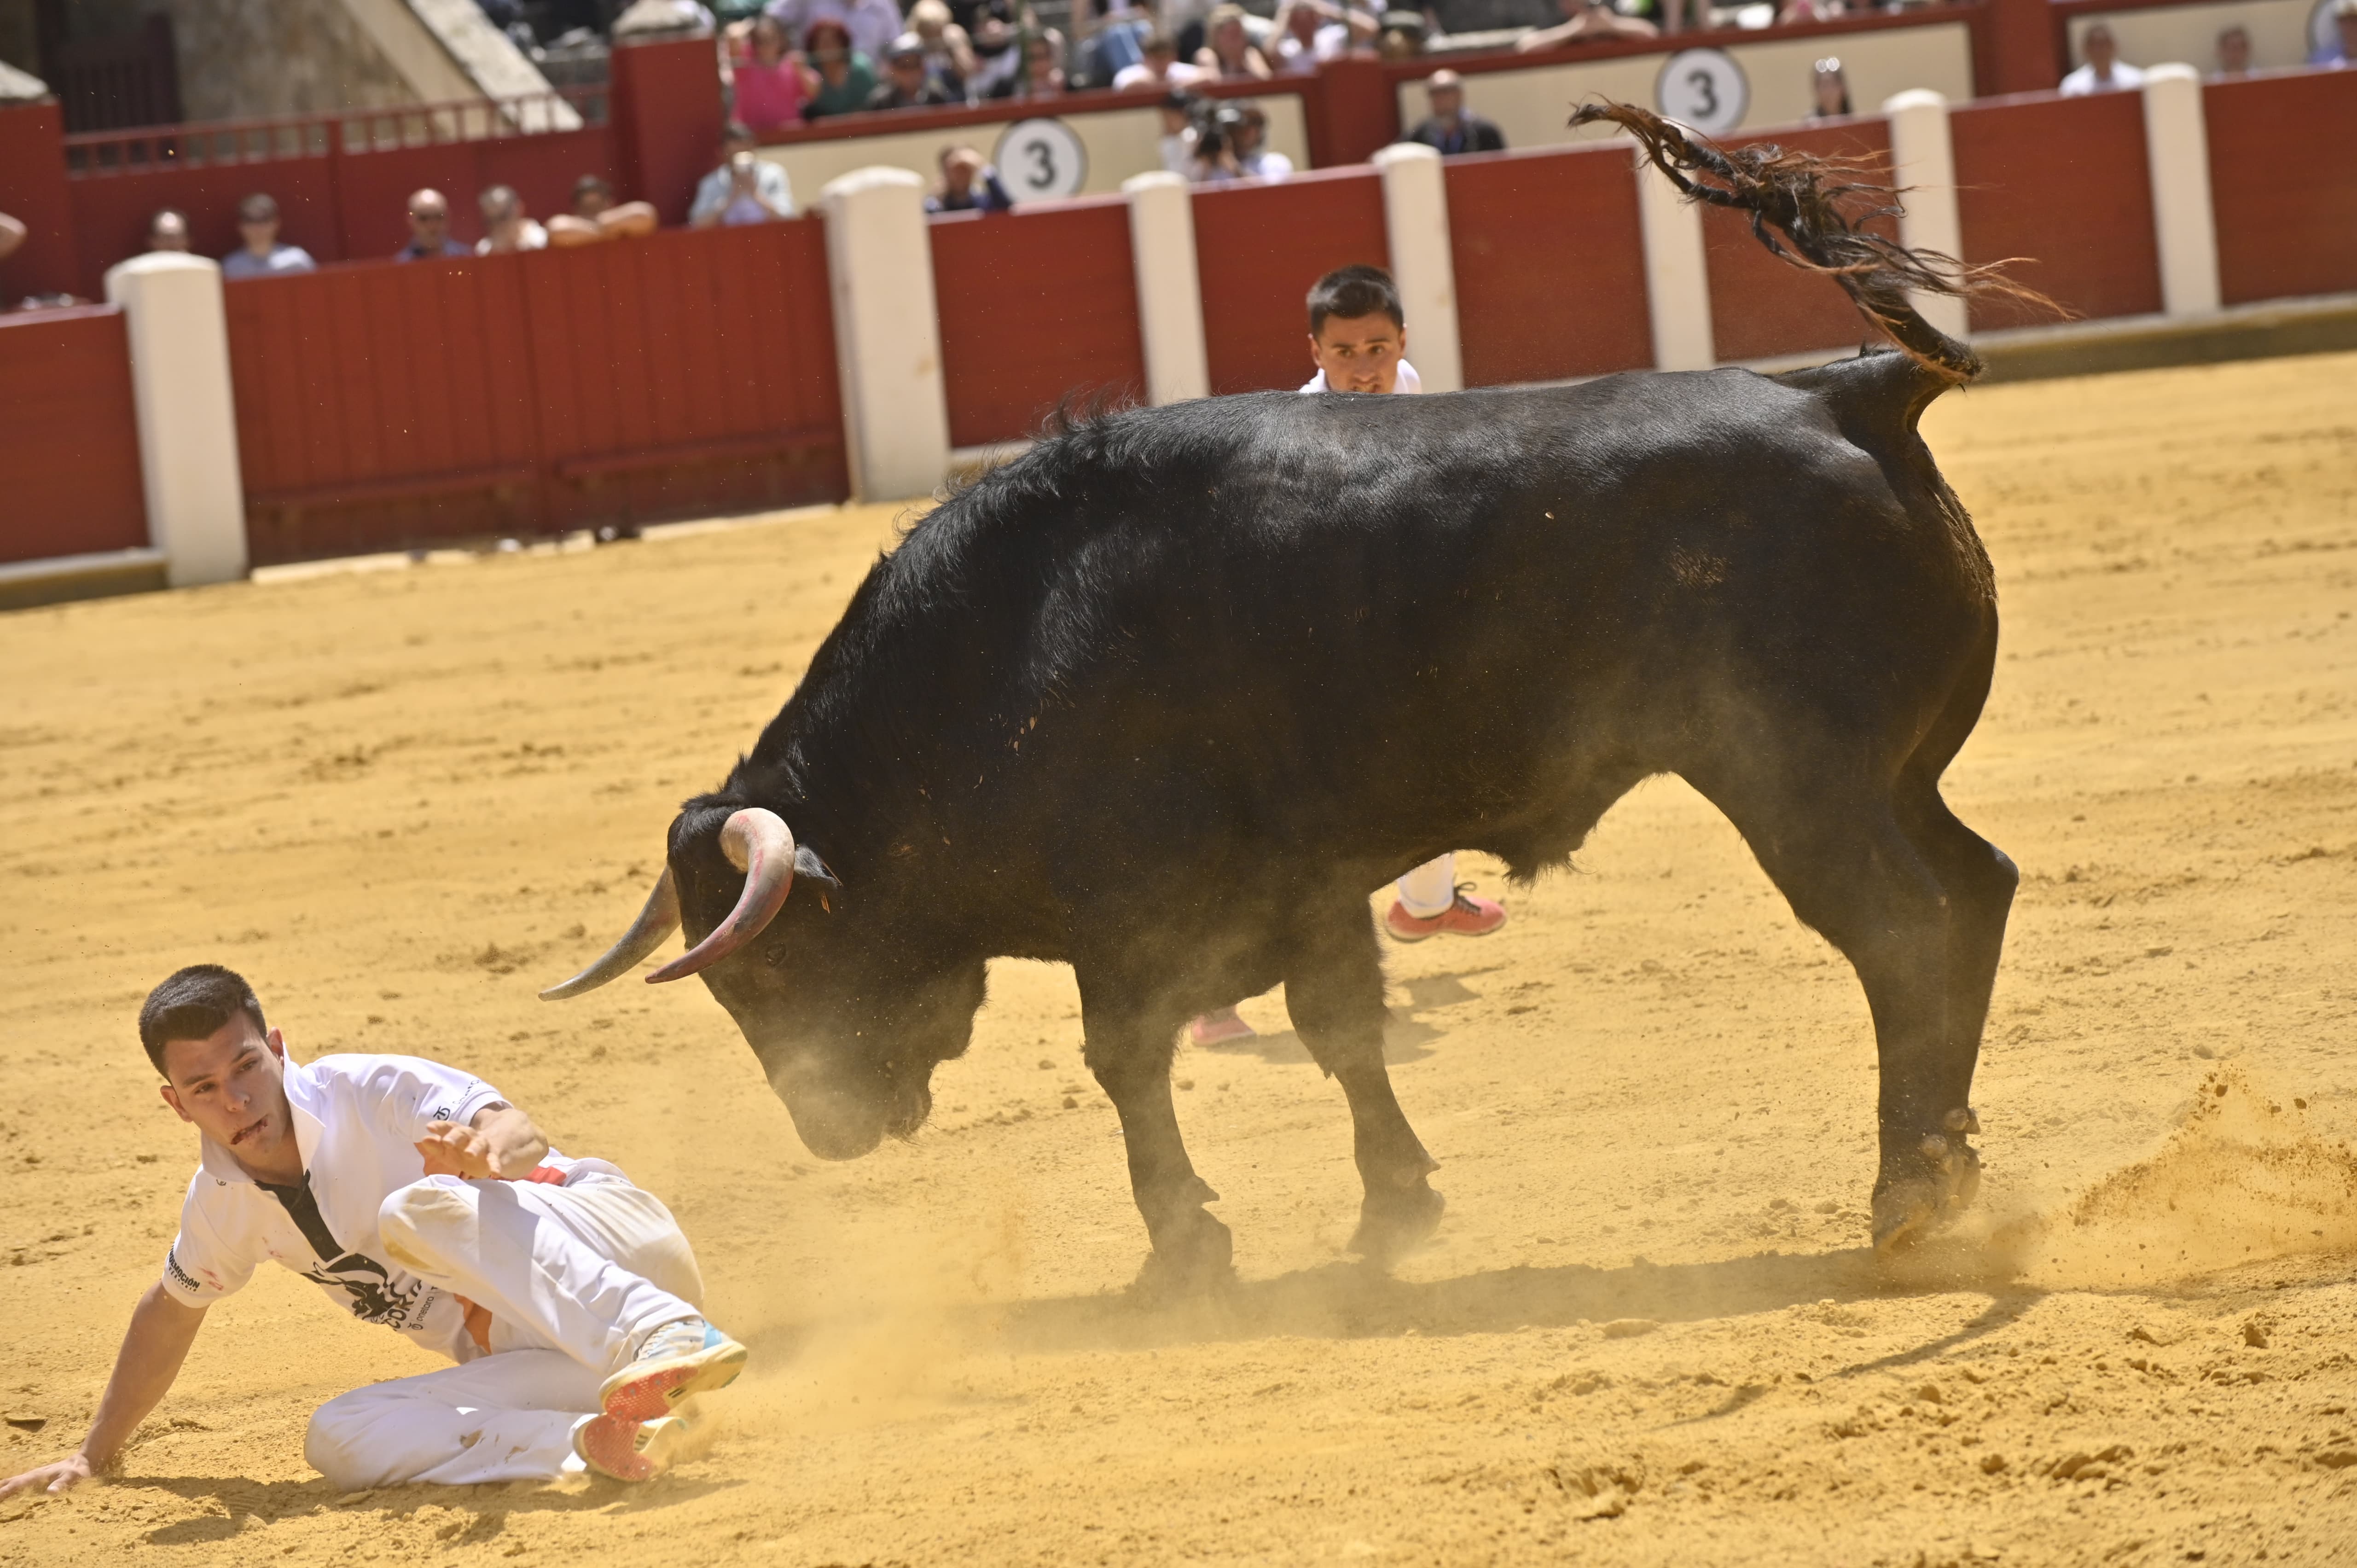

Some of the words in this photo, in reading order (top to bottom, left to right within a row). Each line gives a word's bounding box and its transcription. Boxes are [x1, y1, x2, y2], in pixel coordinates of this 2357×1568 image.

[1687, 70, 1718, 119] 3
[1025, 139, 1056, 190] 3
[416, 1296, 435, 1322] onetoro
